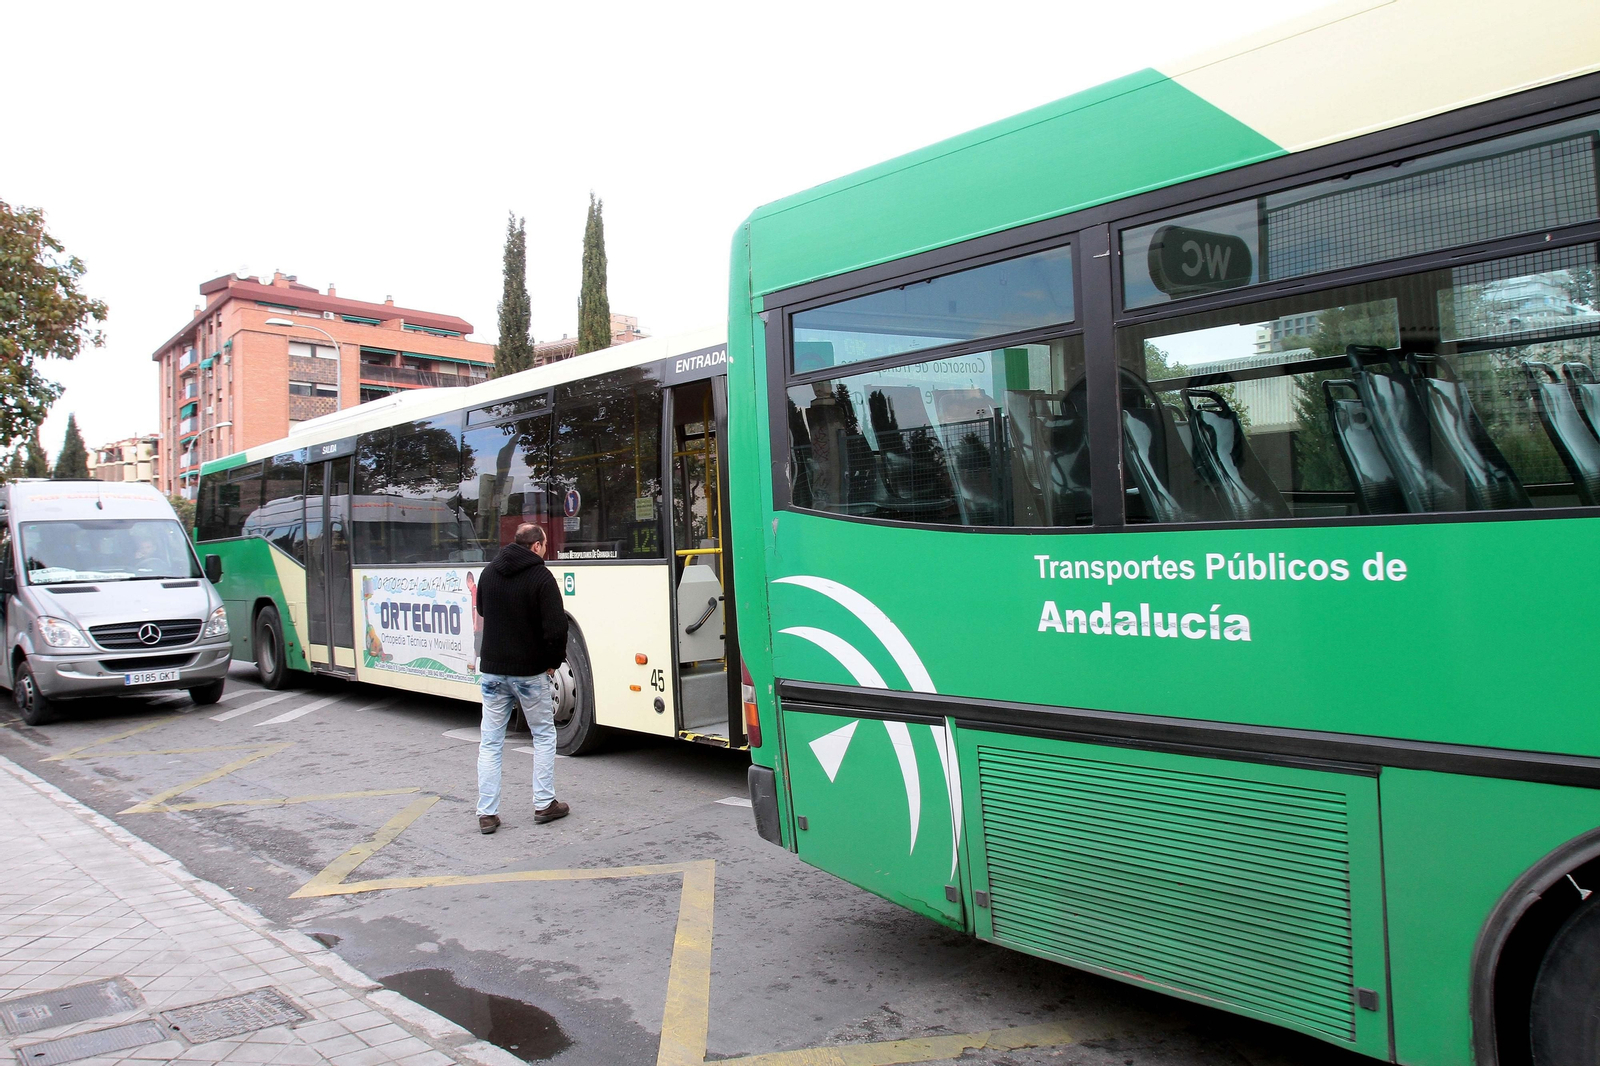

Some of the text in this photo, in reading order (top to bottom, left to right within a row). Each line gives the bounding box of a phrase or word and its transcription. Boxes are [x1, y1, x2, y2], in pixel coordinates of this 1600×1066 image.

[675, 349, 727, 374] ENTRADA
[322, 444, 337, 455] SALIDA
[1034, 551, 1408, 585] Transportes Públicos de
[421, 575, 463, 593] INFANTIL
[380, 602, 461, 635] ORTECMO
[1037, 599, 1252, 642] Andalucía
[382, 634, 462, 652] Ortopedia Técnica y Movilidad
[133, 671, 177, 684] 9185 GKT
[650, 668, 665, 693] 45
